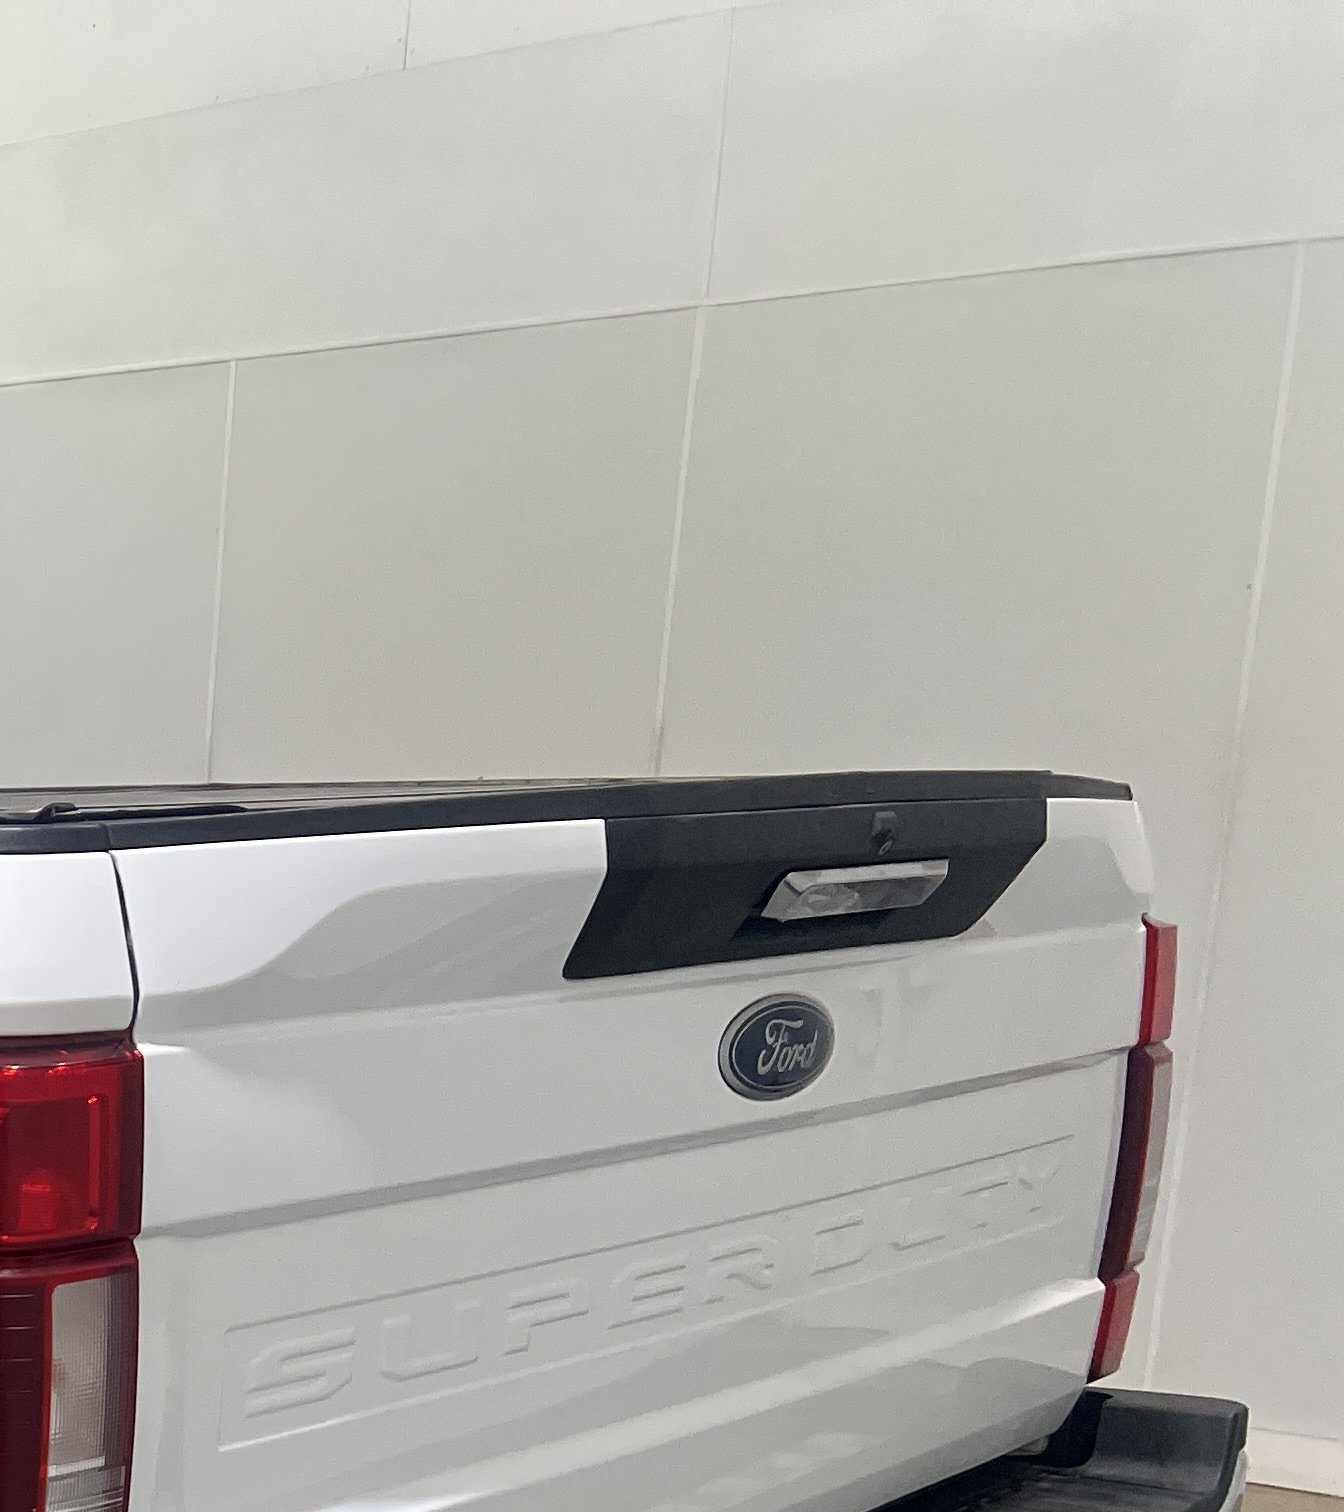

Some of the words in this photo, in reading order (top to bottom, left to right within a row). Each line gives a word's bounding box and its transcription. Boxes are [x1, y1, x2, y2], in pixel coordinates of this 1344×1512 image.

[757, 1018, 819, 1076] Ford
[244, 1230, 780, 1420] SUPER
[809, 1159, 1066, 1277] DUTY
